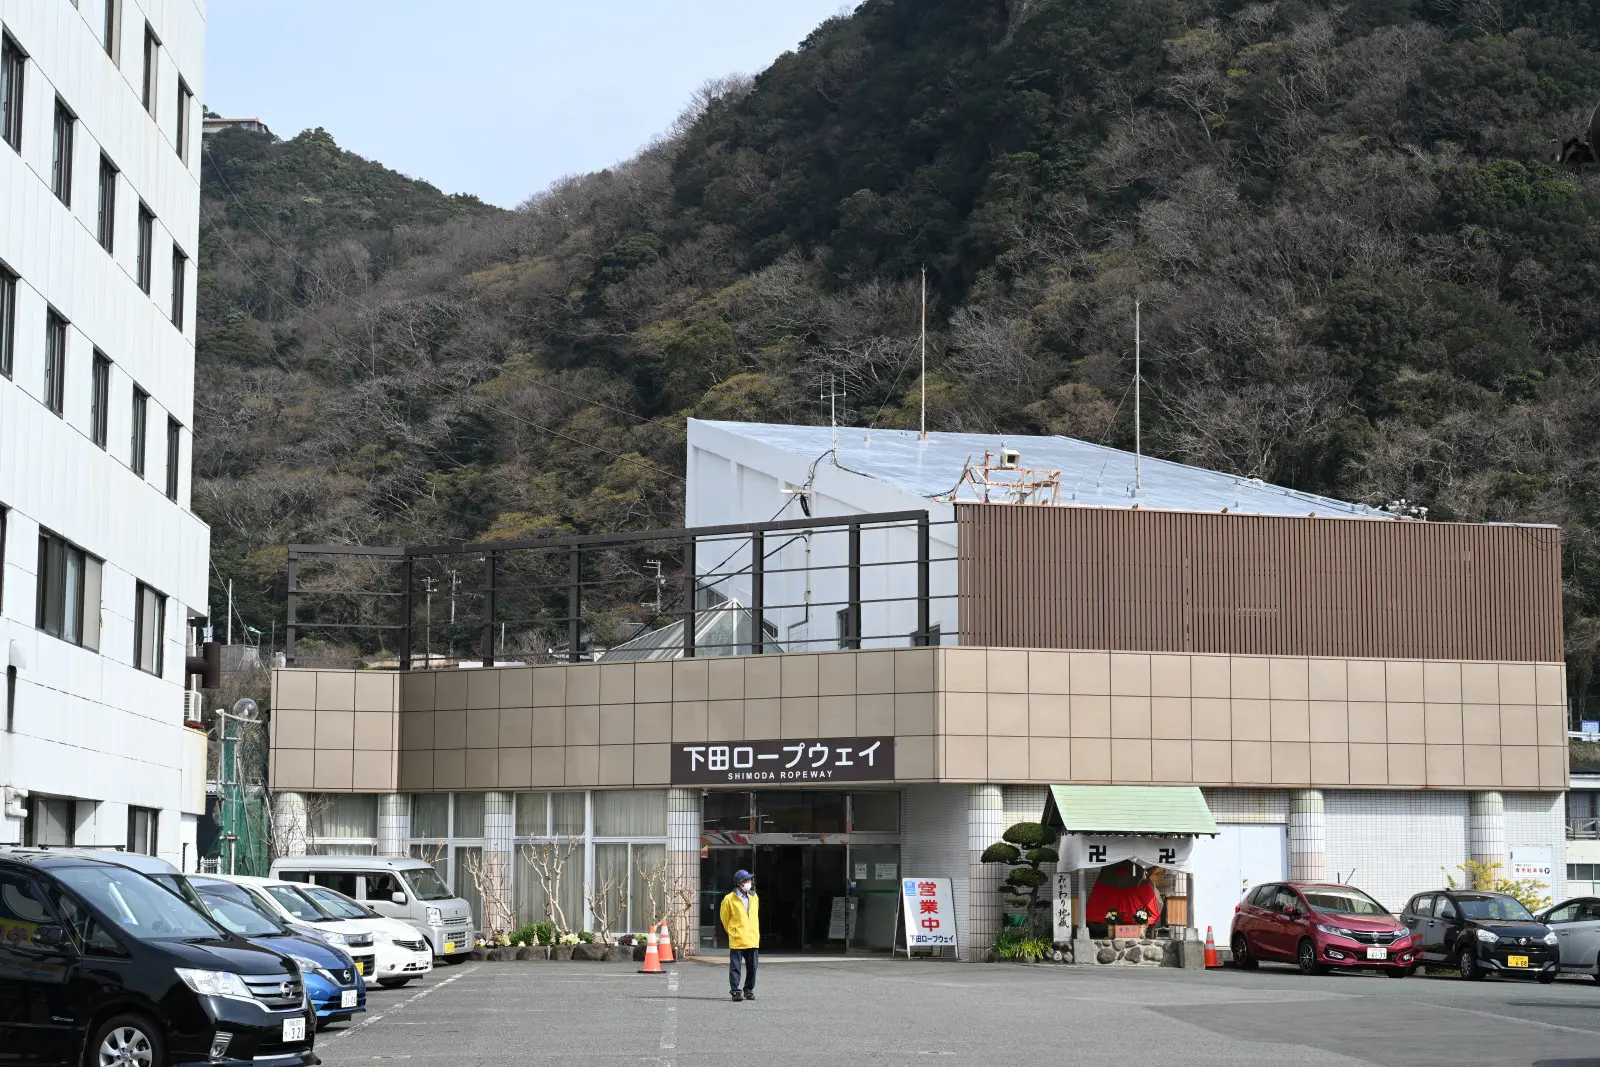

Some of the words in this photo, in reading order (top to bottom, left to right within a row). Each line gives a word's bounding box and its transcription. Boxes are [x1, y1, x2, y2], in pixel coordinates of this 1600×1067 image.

[683, 741, 881, 772] 下田ロープウェイ
[727, 772, 775, 780] SHIMODA
[780, 770, 833, 779] ROPEWAY
[918, 881, 940, 933] 営業中
